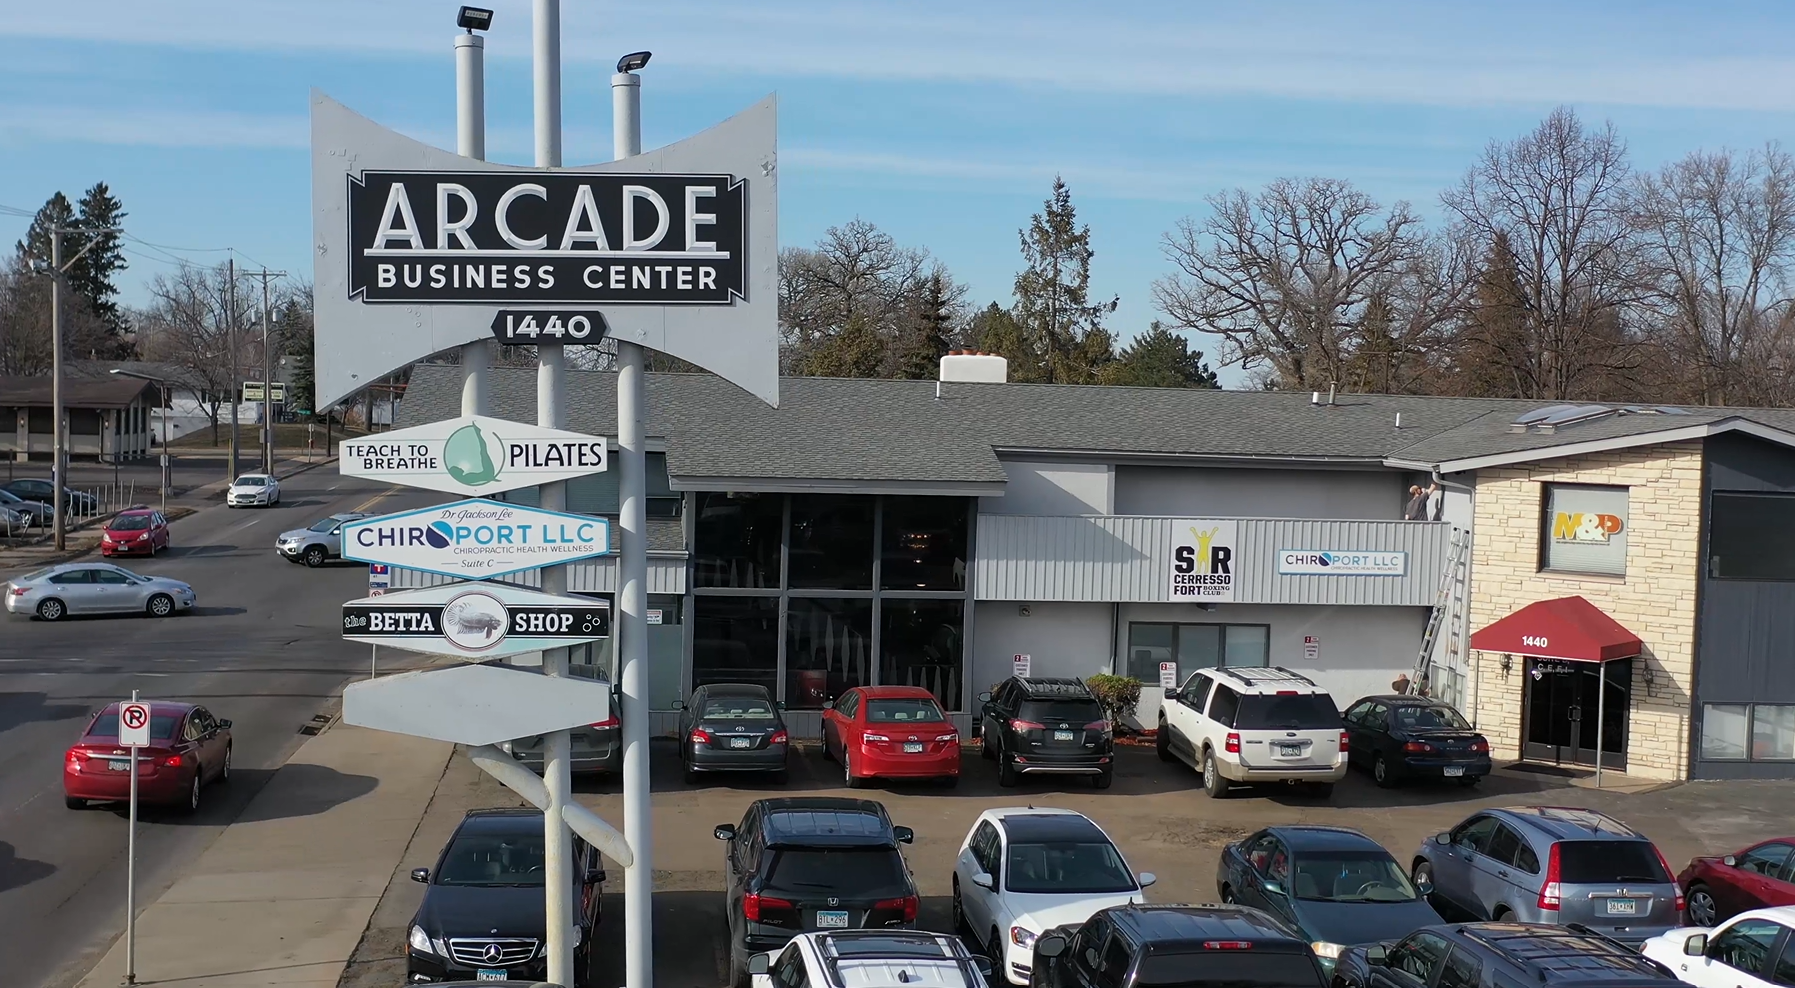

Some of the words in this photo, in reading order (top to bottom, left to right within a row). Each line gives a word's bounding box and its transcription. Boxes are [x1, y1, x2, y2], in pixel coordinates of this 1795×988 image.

[373, 182, 717, 252] ARCADE
[377, 263, 555, 289] BUSINESS
[583, 264, 717, 290] CENTER
[506, 314, 592, 338] 1440
[346, 445, 401, 457] TEACH
[408, 445, 429, 457] TO
[510, 443, 602, 468] PILATES
[363, 458, 438, 470] BREATHE
[440, 509, 455, 519] Dr
[456, 509, 498, 524] Jackson
[495, 508, 514, 521] Lee
[543, 523, 594, 544] LLC
[1553, 512, 1622, 541] M&P
[453, 546, 515, 555] CHIROPRACTIC
[516, 545, 548, 553] HEALTH
[550, 545, 594, 553] WELLNESS
[461, 558, 485, 568] Suite
[486, 559, 494, 568] C
[1373, 556, 1399, 567] LLC
[1173, 574, 1231, 585] CERRESSO
[1173, 585, 1203, 596] FORT
[344, 615, 367, 628] the
[369, 612, 435, 631] BETTA
[515, 613, 574, 632] SHOP
[1521, 635, 1548, 648] 1440
